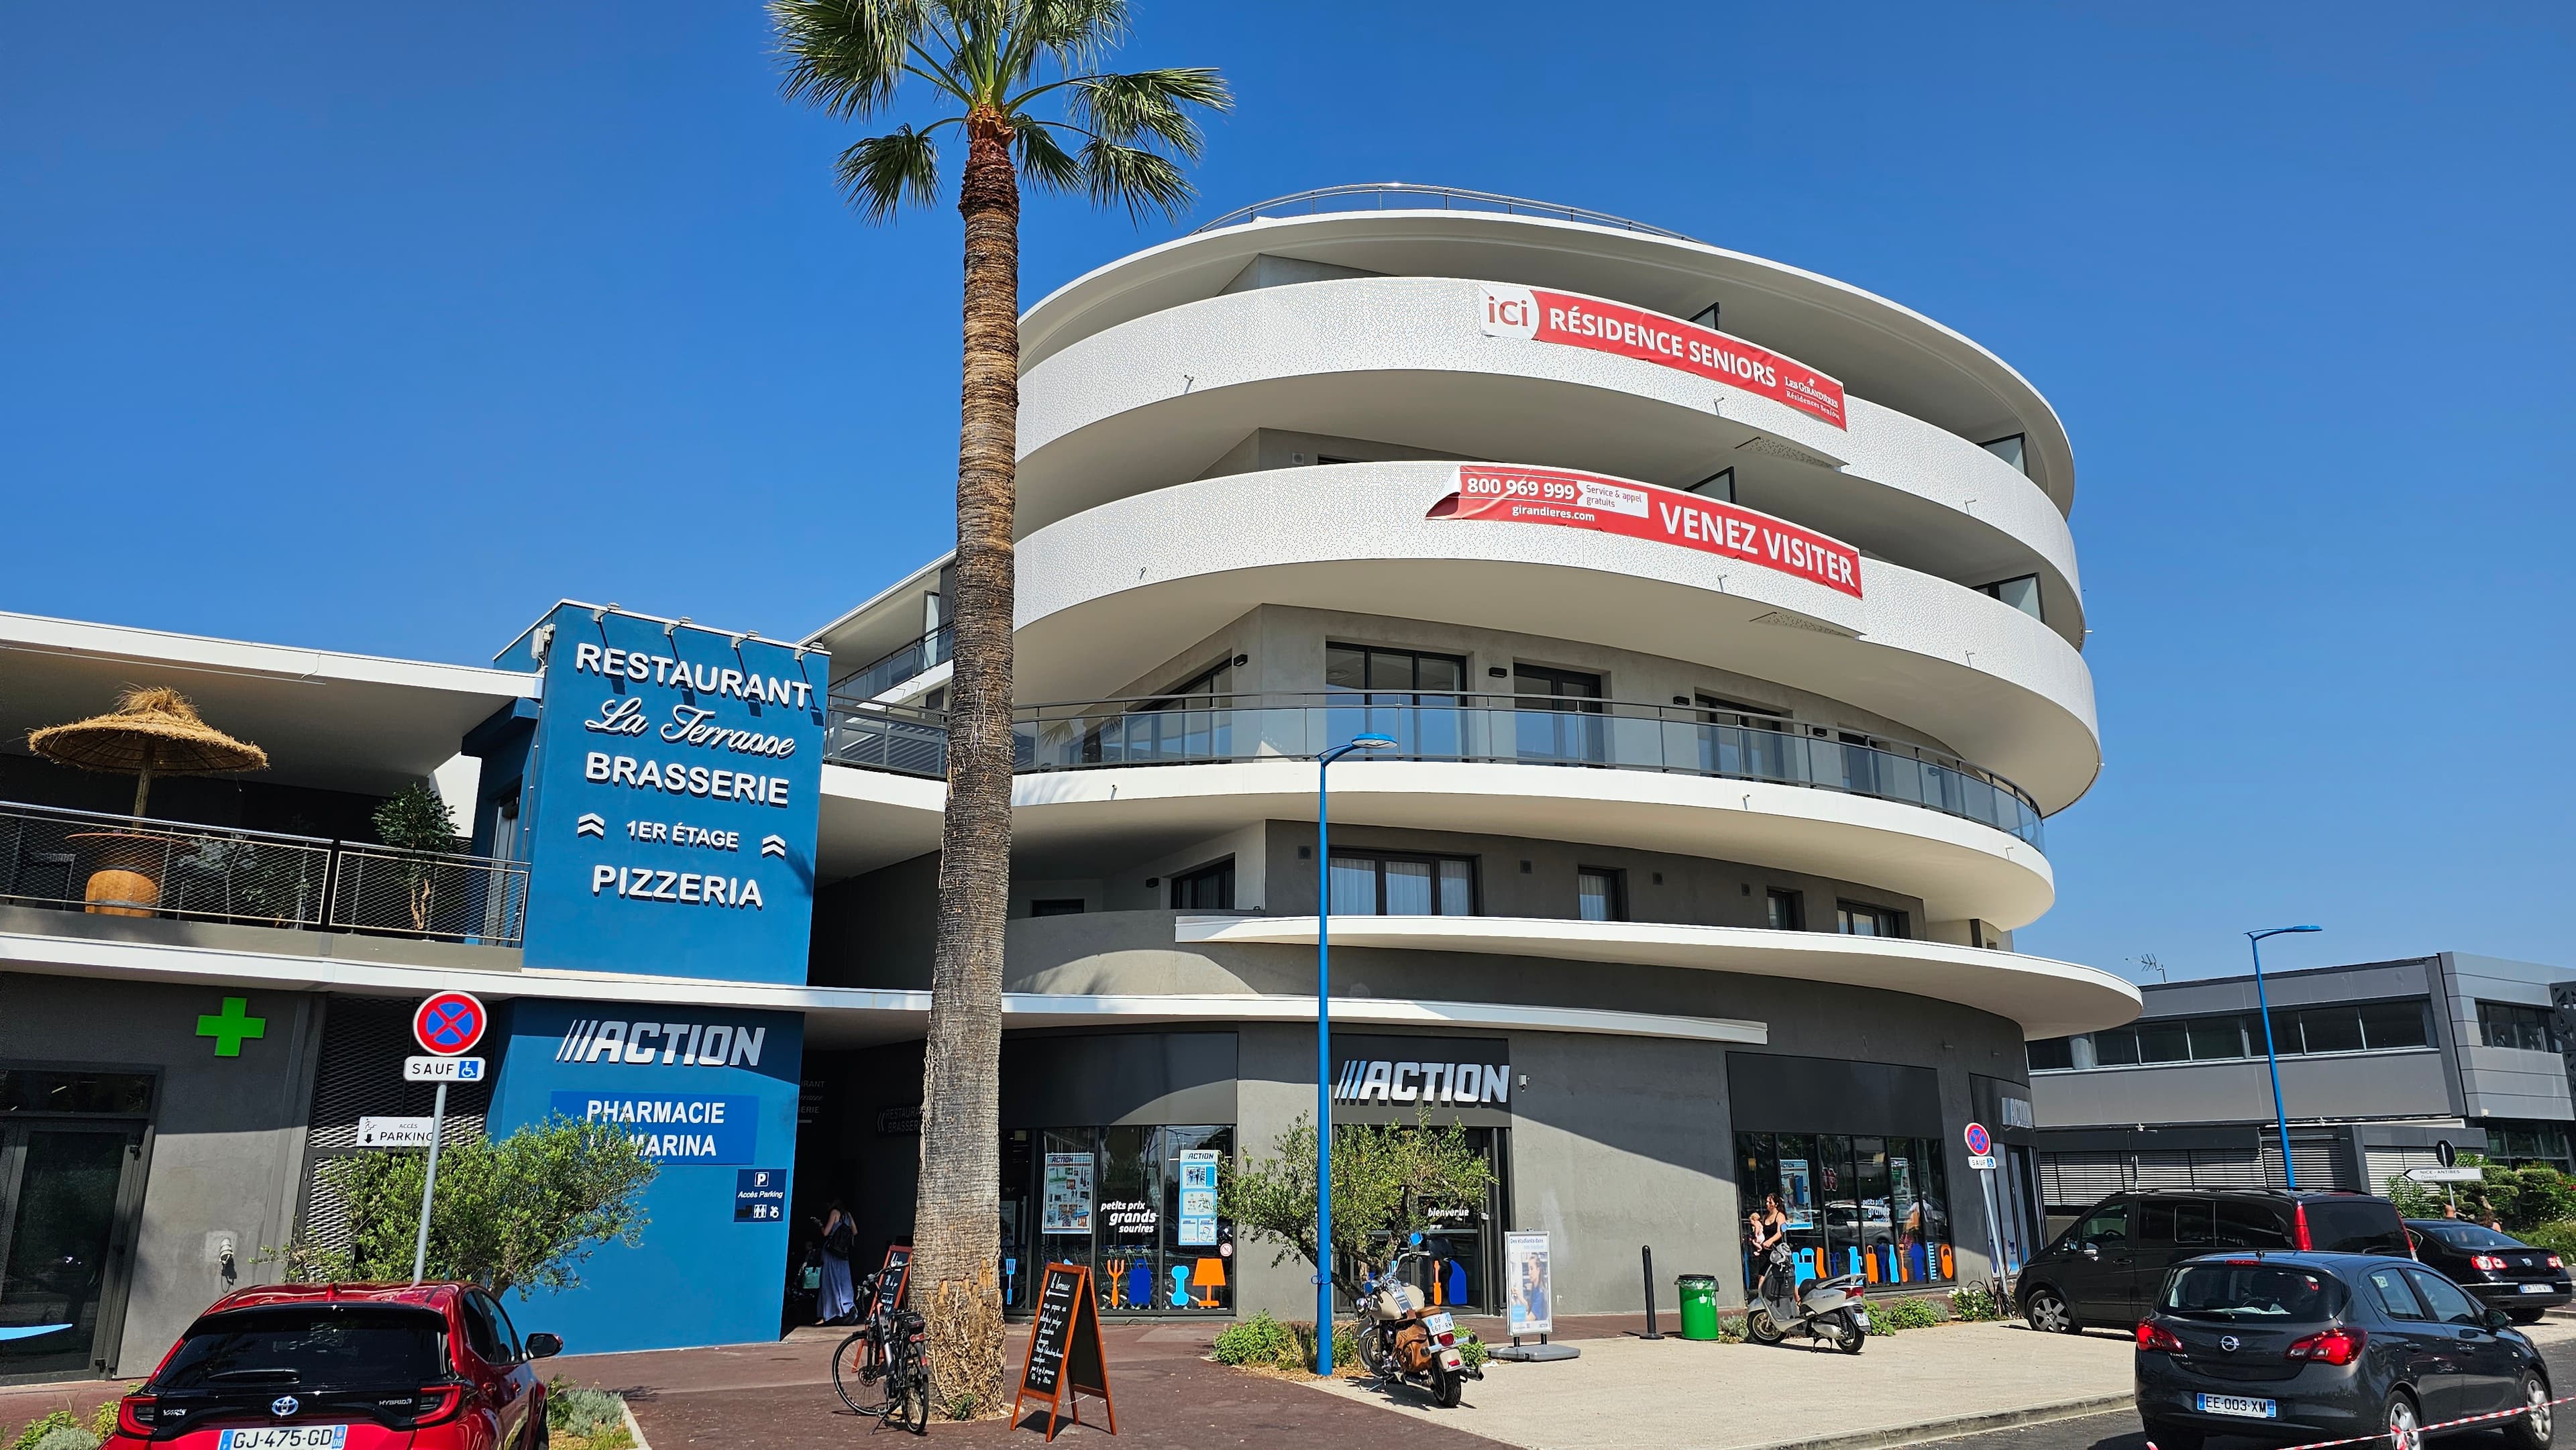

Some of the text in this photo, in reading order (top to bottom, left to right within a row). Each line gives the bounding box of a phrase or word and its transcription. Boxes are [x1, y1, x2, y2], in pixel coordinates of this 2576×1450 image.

[1549, 306, 1776, 388] RÉSIDENCE SENIORS
[1784, 376, 1799, 389] LES
[1786, 390, 1820, 408] Résidences
[1467, 478, 1574, 499] 800 969 999
[1586, 485, 1642, 502] Service & appel
[1586, 497, 1615, 508] gratuits
[1512, 504, 1595, 522] girandieres.com
[1659, 502, 1856, 588] VENEZ VISITER
[576, 642, 813, 708] RESTAURANT
[585, 697, 796, 757] La Terrasse
[585, 752, 790, 806] BRASSERIE
[627, 820, 739, 848] 1ER ÉTAGE
[592, 865, 763, 907] PIZZERIA
[585, 1021, 765, 1066] ACTION
[413, 1063, 454, 1075] SAUF
[1358, 1060, 1510, 1103] ACTION
[586, 1100, 725, 1123] PHARMACIE
[885, 1107, 920, 1119] RESTAURA
[888, 1120, 920, 1133] BRASSERI
[1100, 1201, 1145, 1212] petits prix
[1109, 1209, 1157, 1225] grands
[1118, 1223, 1154, 1233] sourires
[2206, 1396, 2266, 1413] EE-003-XM
[233, 1429, 333, 1448] GJ-475-GD
